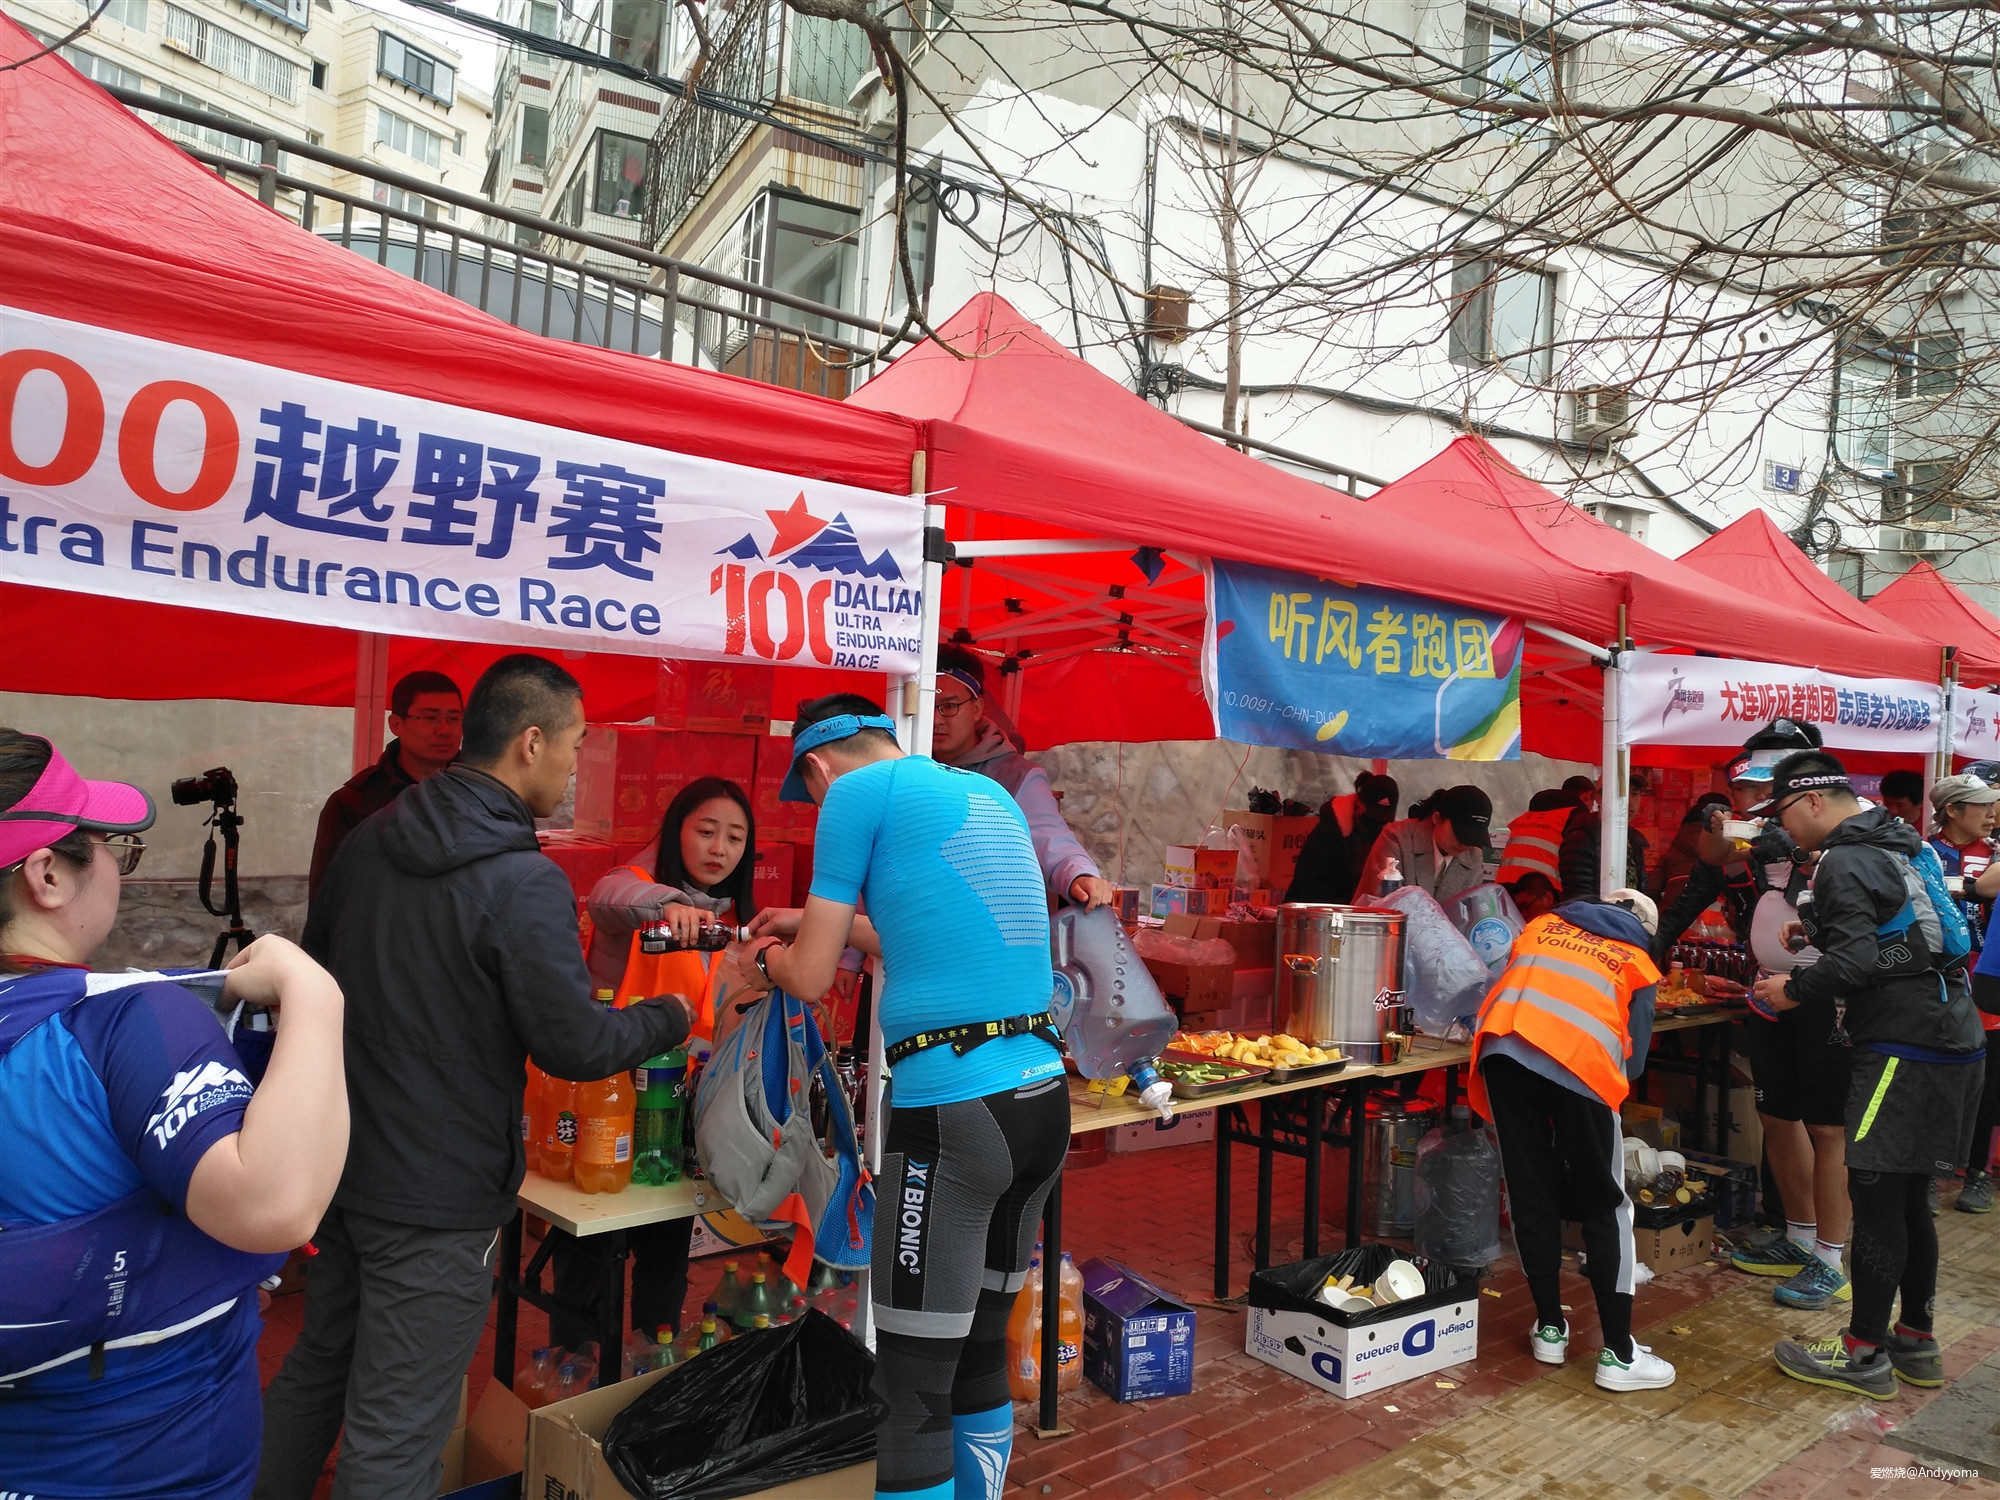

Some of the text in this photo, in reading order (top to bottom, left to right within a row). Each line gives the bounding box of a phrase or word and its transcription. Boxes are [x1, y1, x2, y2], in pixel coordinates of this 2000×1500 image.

[1781, 469, 1790, 483] 3
[131, 520, 500, 617] Endurance
[519, 577, 661, 636] Race
[835, 611, 883, 632] ULTRA
[1269, 591, 1496, 680] 听风者跑团
[834, 652, 881, 670] RACE
[200, 1084, 253, 1102] DALIAN
[1182, 1109, 1213, 1120] Banana
[899, 1187, 925, 1267] BIONIC
[113, 1250, 127, 1272] 5
[1402, 1318, 1436, 1357] D
[1438, 1319, 1474, 1339] Delight
[1355, 1341, 1399, 1363] Banana
[1311, 1351, 1342, 1385] D
